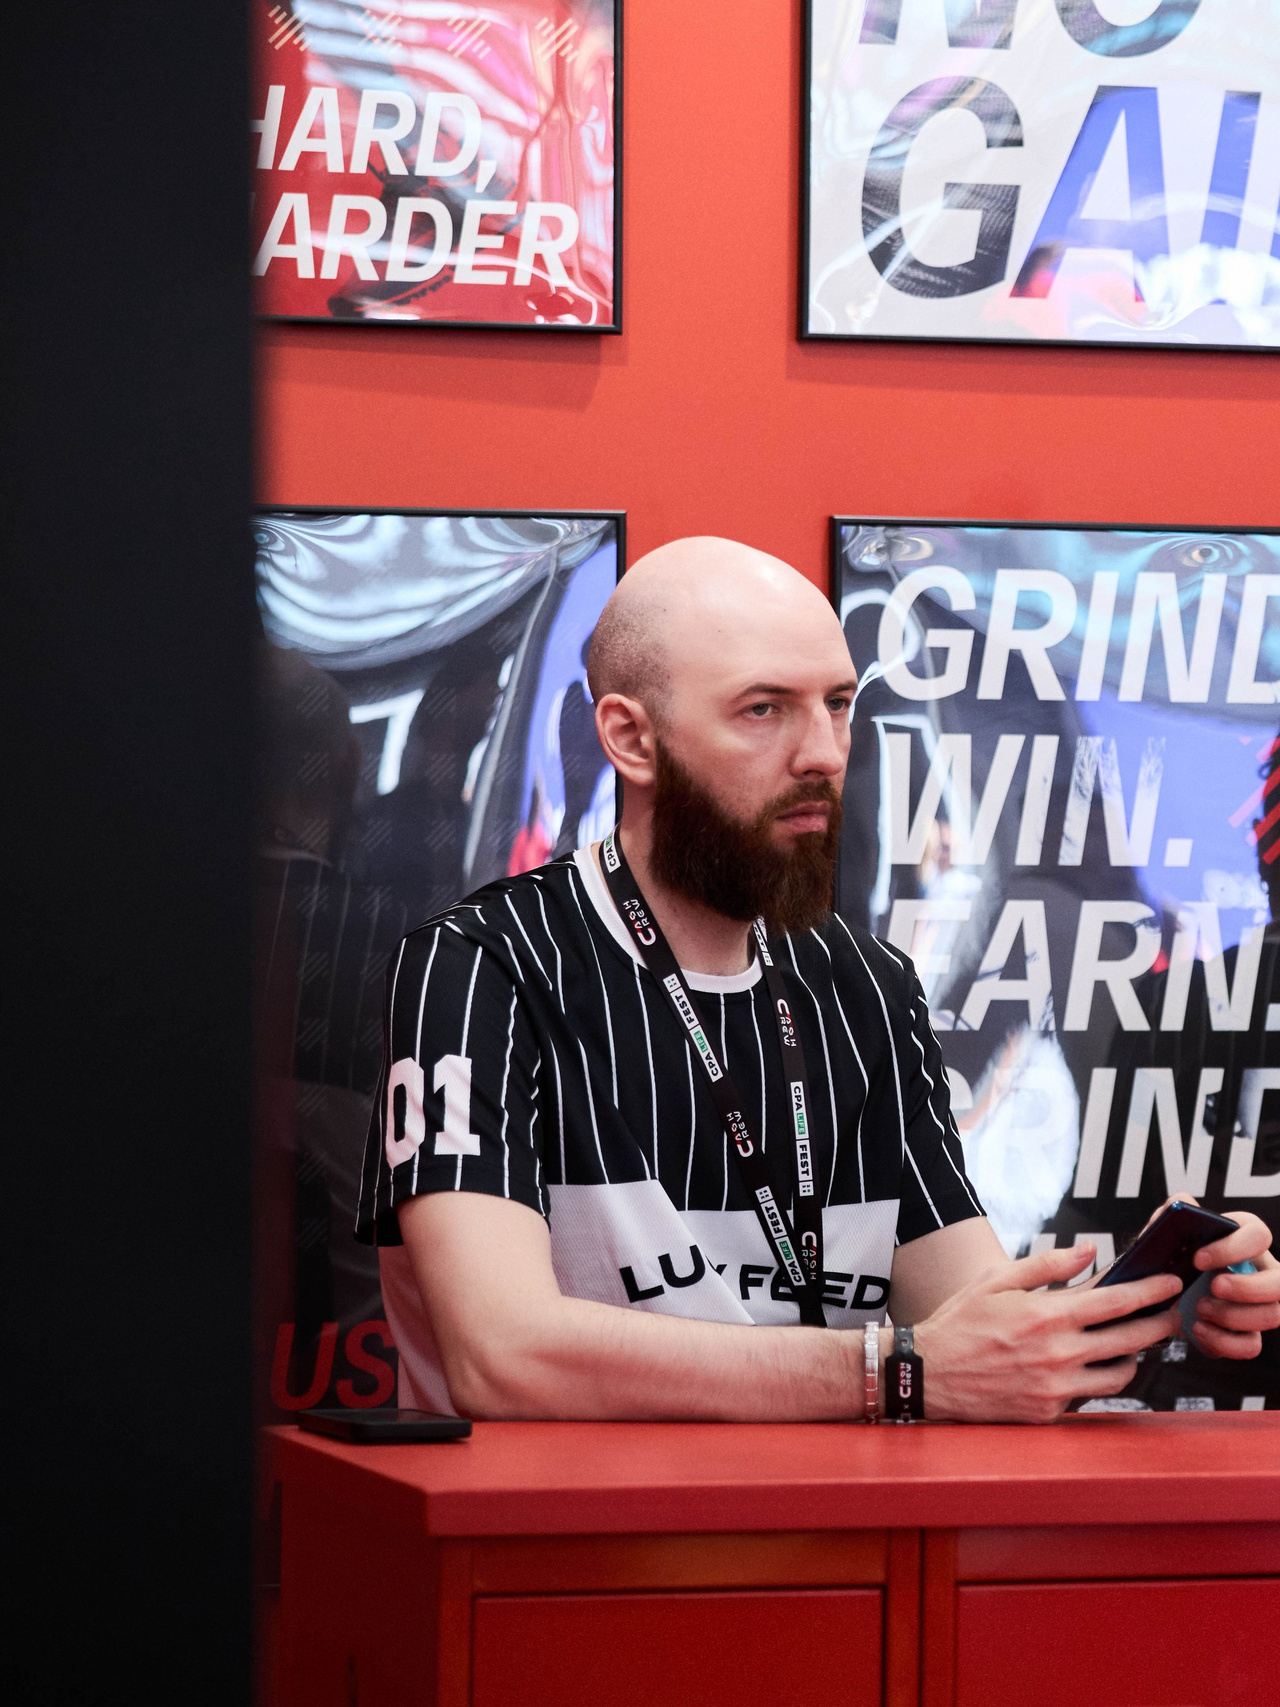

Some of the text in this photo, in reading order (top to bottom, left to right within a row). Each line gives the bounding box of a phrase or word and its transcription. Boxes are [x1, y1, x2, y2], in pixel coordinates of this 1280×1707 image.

[250, 191, 579, 286] ARDER
[885, 733, 1193, 868] WIN.
[674, 994, 719, 1077] CPA LIFE FEST
[385, 1054, 481, 1169] 01
[793, 1085, 810, 1176] CPA LIFE FEST
[765, 1205, 802, 1283] CPA LIFE FEST
